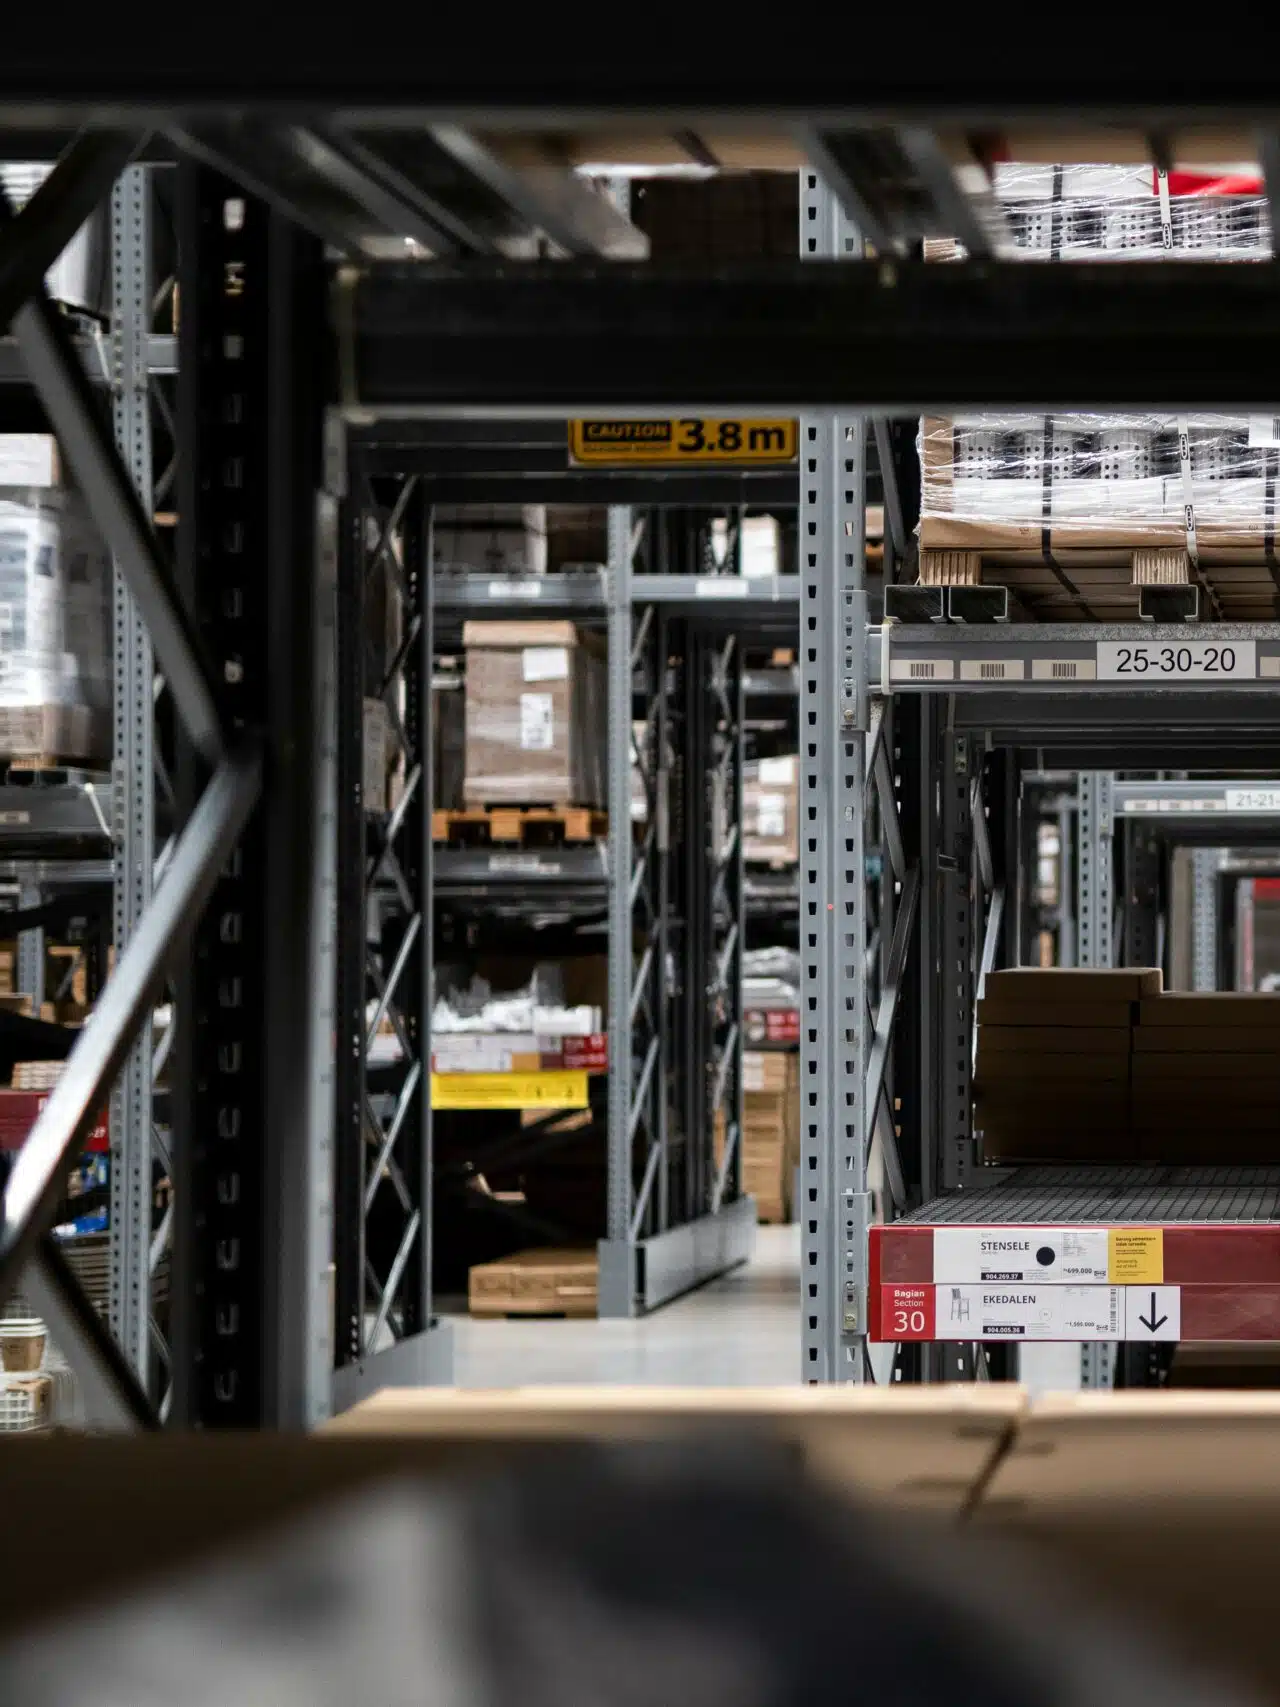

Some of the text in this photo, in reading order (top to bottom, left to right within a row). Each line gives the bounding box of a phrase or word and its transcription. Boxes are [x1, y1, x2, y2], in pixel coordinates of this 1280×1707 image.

[586, 422, 669, 438] CAUTION
[678, 419, 784, 451] 3.8 m
[1117, 648, 1236, 672] 25-30-20
[981, 1241, 1030, 1251] STENSELE
[894, 1290, 925, 1299] Bagian
[983, 1295, 1036, 1304] EKEDALEN
[894, 1299, 924, 1307] Section
[894, 1311, 925, 1332] 30
